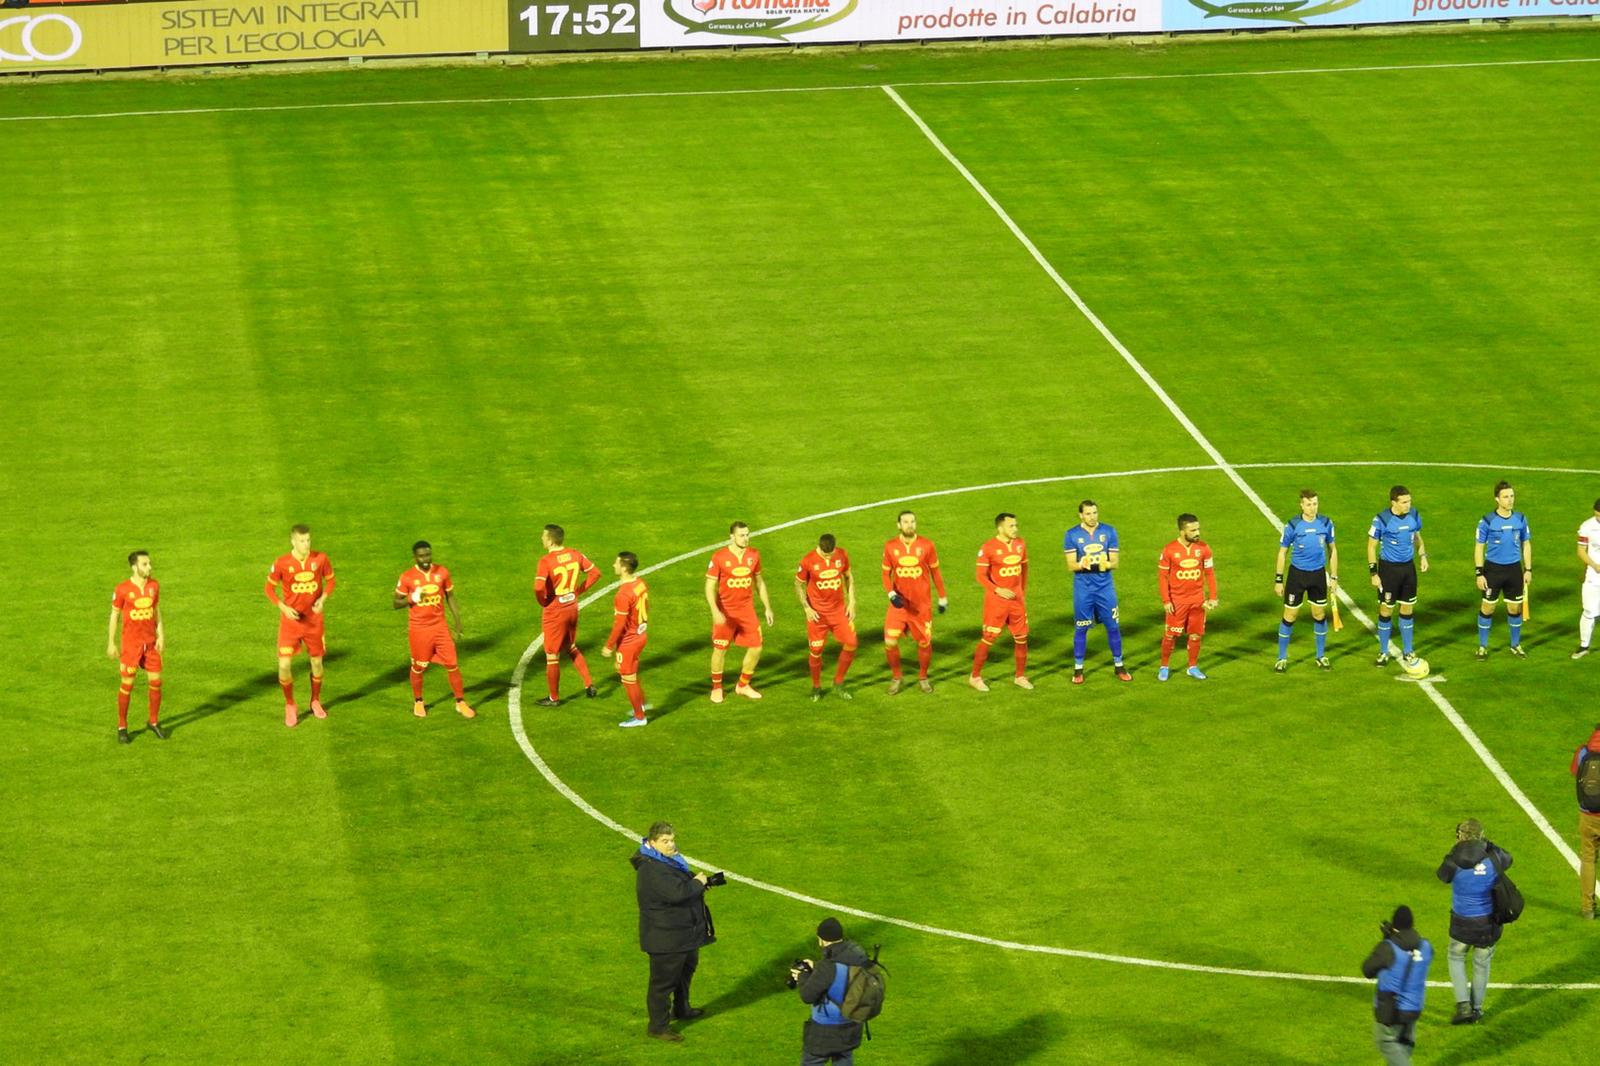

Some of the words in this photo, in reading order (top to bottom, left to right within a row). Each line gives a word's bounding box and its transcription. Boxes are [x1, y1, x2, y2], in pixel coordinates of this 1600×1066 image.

[161, 6, 264, 30] SISTEMI
[277, 0, 418, 24] INTEGRATI
[519, 3, 637, 36] 17:52
[898, 7, 998, 35] prodotte
[1006, 7, 1027, 26] in
[1036, 3, 1137, 25] Calabria
[164, 35, 218, 56] PER
[226, 28, 386, 54] L'ECOLOGIA
[553, 561, 580, 595] 27
